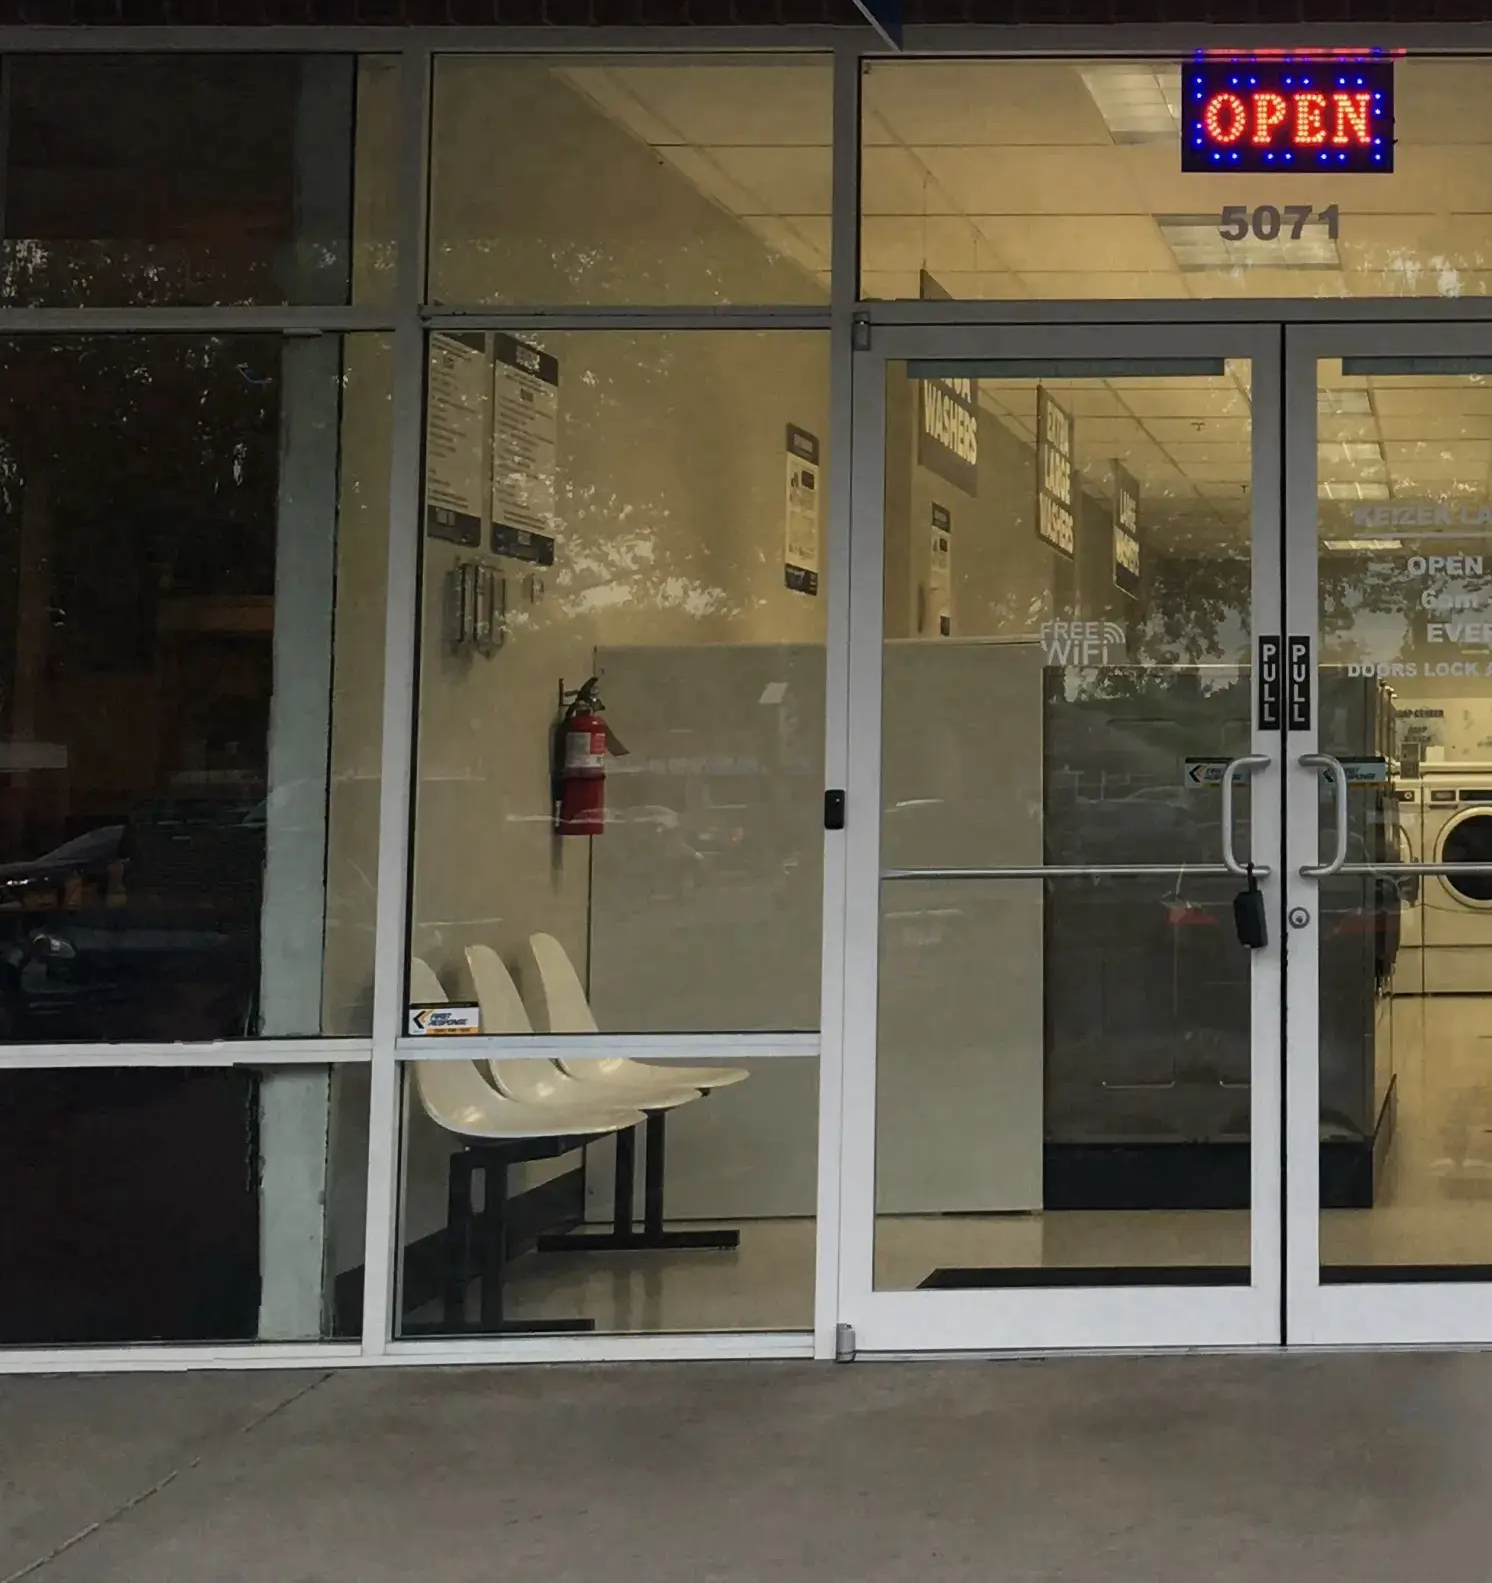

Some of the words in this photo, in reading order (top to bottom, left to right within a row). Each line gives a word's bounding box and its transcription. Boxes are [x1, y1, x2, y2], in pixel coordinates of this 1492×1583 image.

[1205, 92, 1372, 144] OPEN
[1219, 203, 1339, 241] 5071
[924, 379, 978, 466] WASHERS
[1407, 555, 1483, 576] OPEN
[1041, 621, 1099, 640] FREE
[1262, 644, 1277, 722] PULL
[1292, 644, 1306, 723] PULL
[1348, 662, 1417, 678] DOORS
[1424, 662, 1478, 677] LOCK
